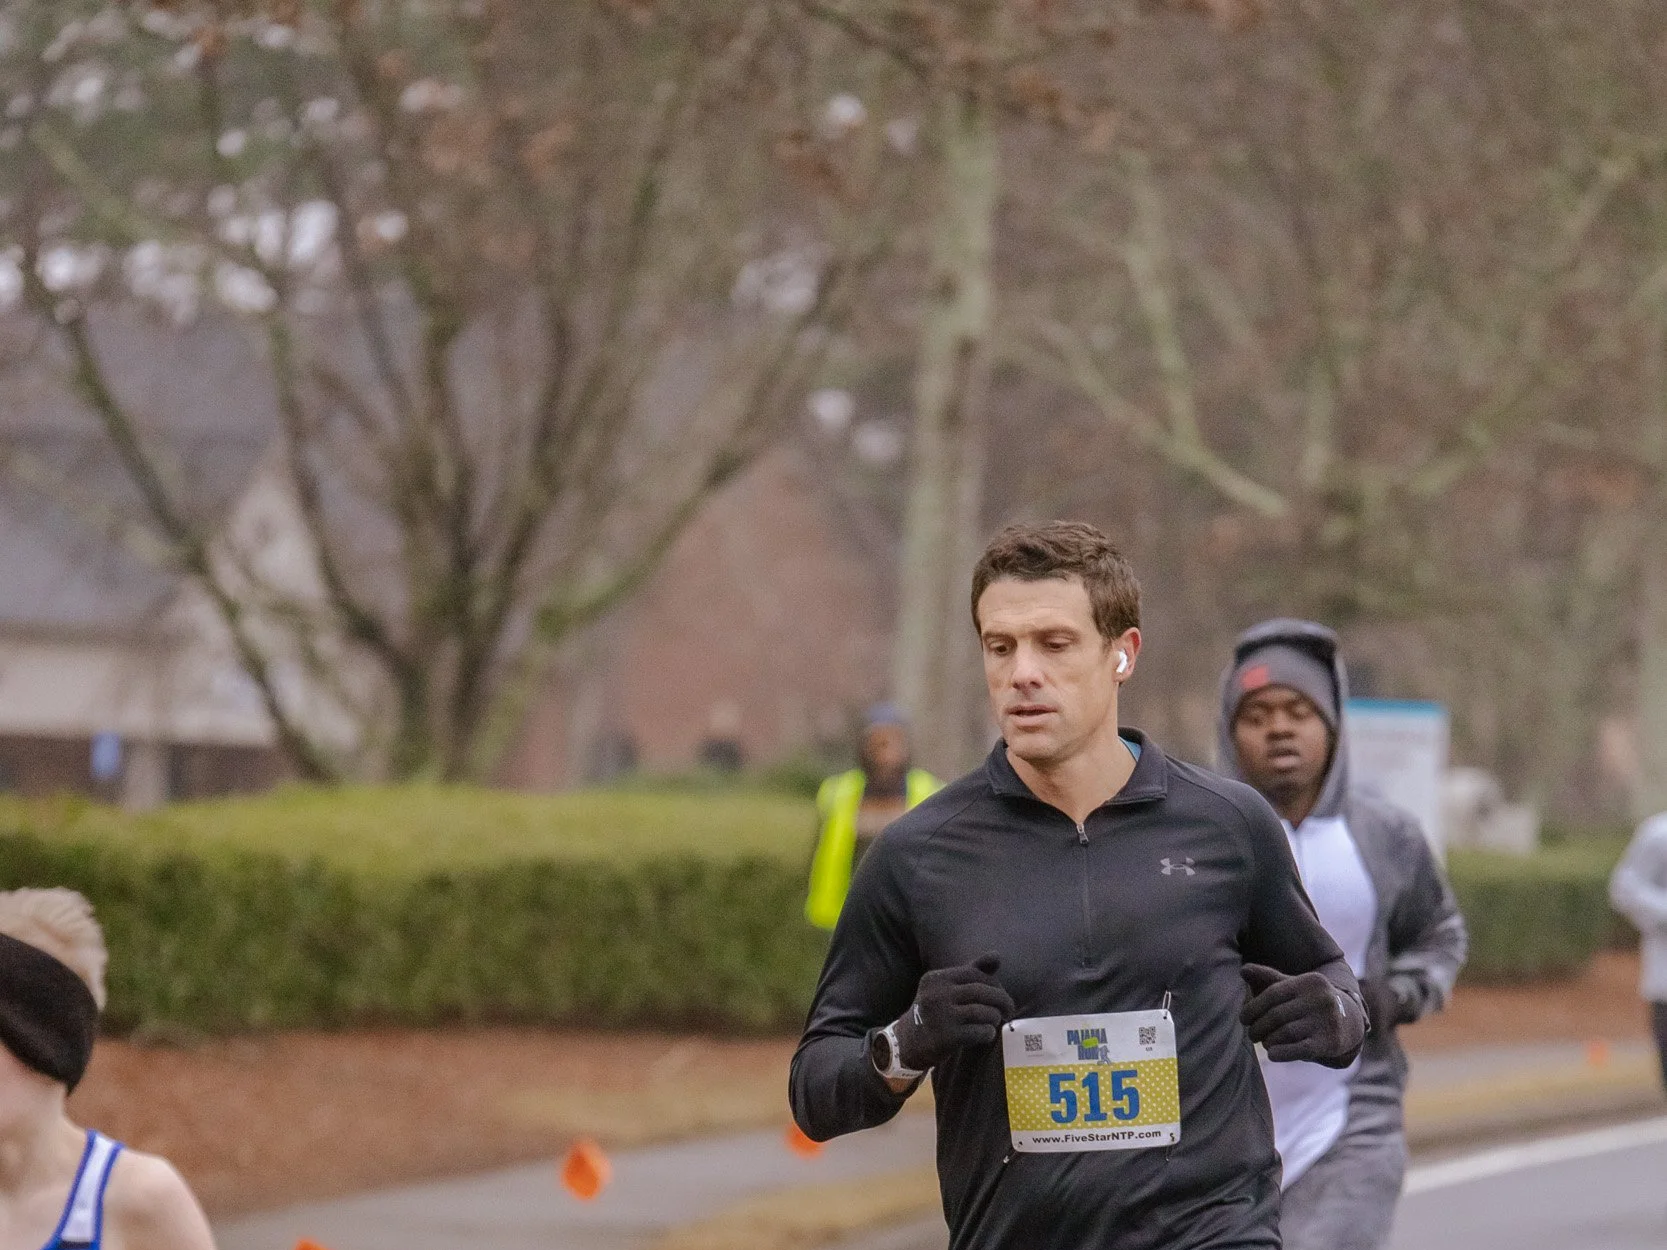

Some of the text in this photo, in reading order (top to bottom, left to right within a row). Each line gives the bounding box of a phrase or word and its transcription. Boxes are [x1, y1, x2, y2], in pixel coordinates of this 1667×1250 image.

[1066, 1028, 1108, 1045] PAJAMA
[1077, 1046, 1099, 1060] RUN
[1048, 1070, 1140, 1124] 515
[1032, 1131, 1162, 1144] www.FiveStarNTP.com
